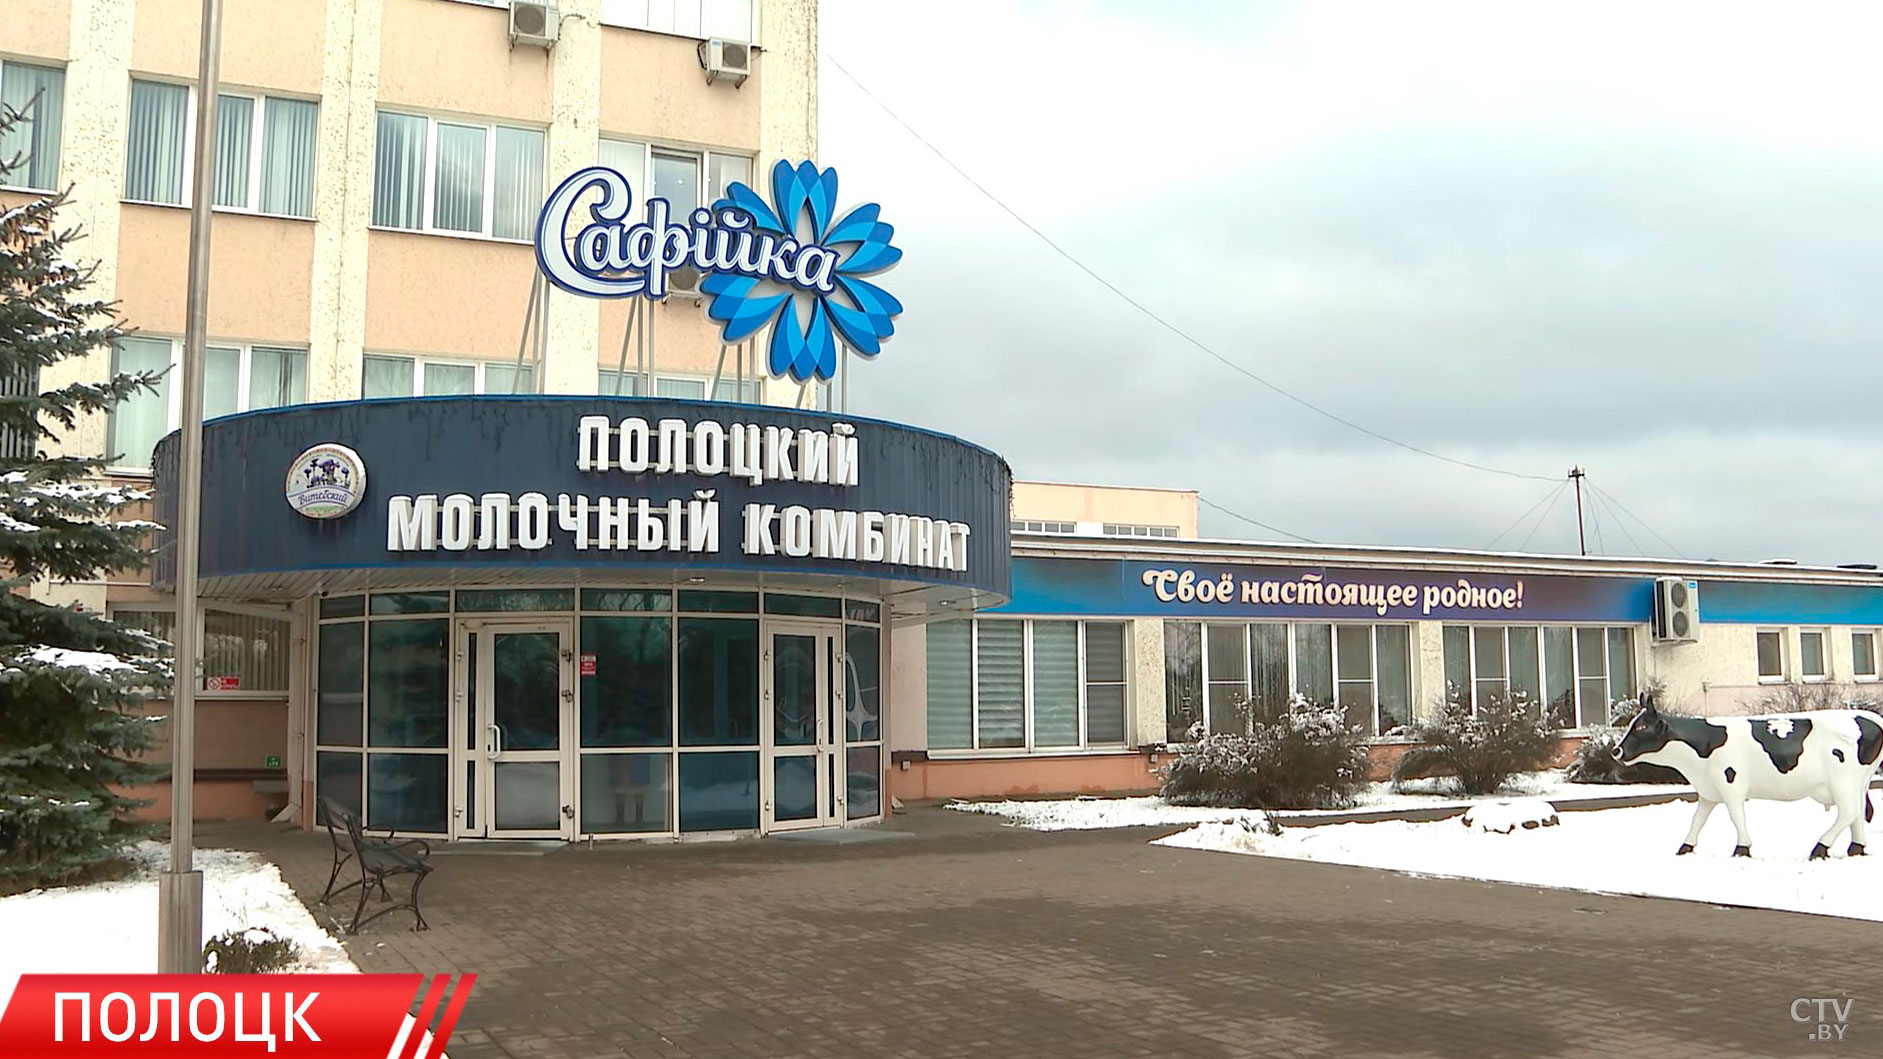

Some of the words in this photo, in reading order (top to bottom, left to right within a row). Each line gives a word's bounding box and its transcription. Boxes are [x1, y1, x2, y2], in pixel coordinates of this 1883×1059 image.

[535, 166, 838, 298] Сафійка
[578, 416, 859, 486] ПОЛОЦКИЙ
[387, 489, 719, 551] МОЛОЧНЫЙ
[743, 503, 971, 571] КОМБИНАТ
[1142, 569, 1234, 602] Своё
[1240, 574, 1418, 616] настоящее
[1422, 578, 1524, 615] родное!
